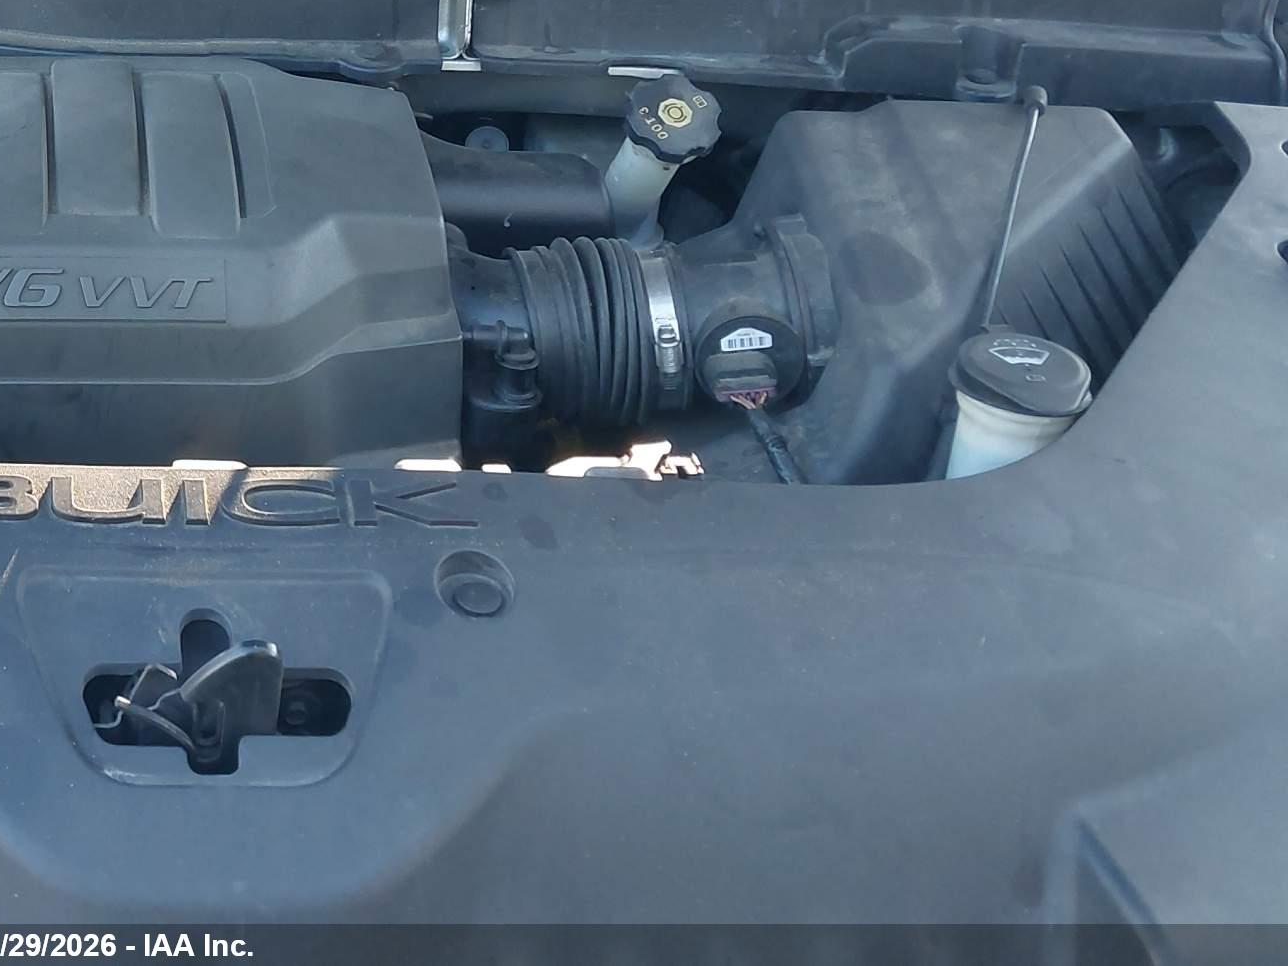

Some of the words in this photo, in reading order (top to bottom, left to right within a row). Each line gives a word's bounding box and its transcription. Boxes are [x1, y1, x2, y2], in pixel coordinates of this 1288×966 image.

[638, 106, 649, 115] 3
[644, 117, 669, 140] DOT
[79, 276, 212, 309] VVT
